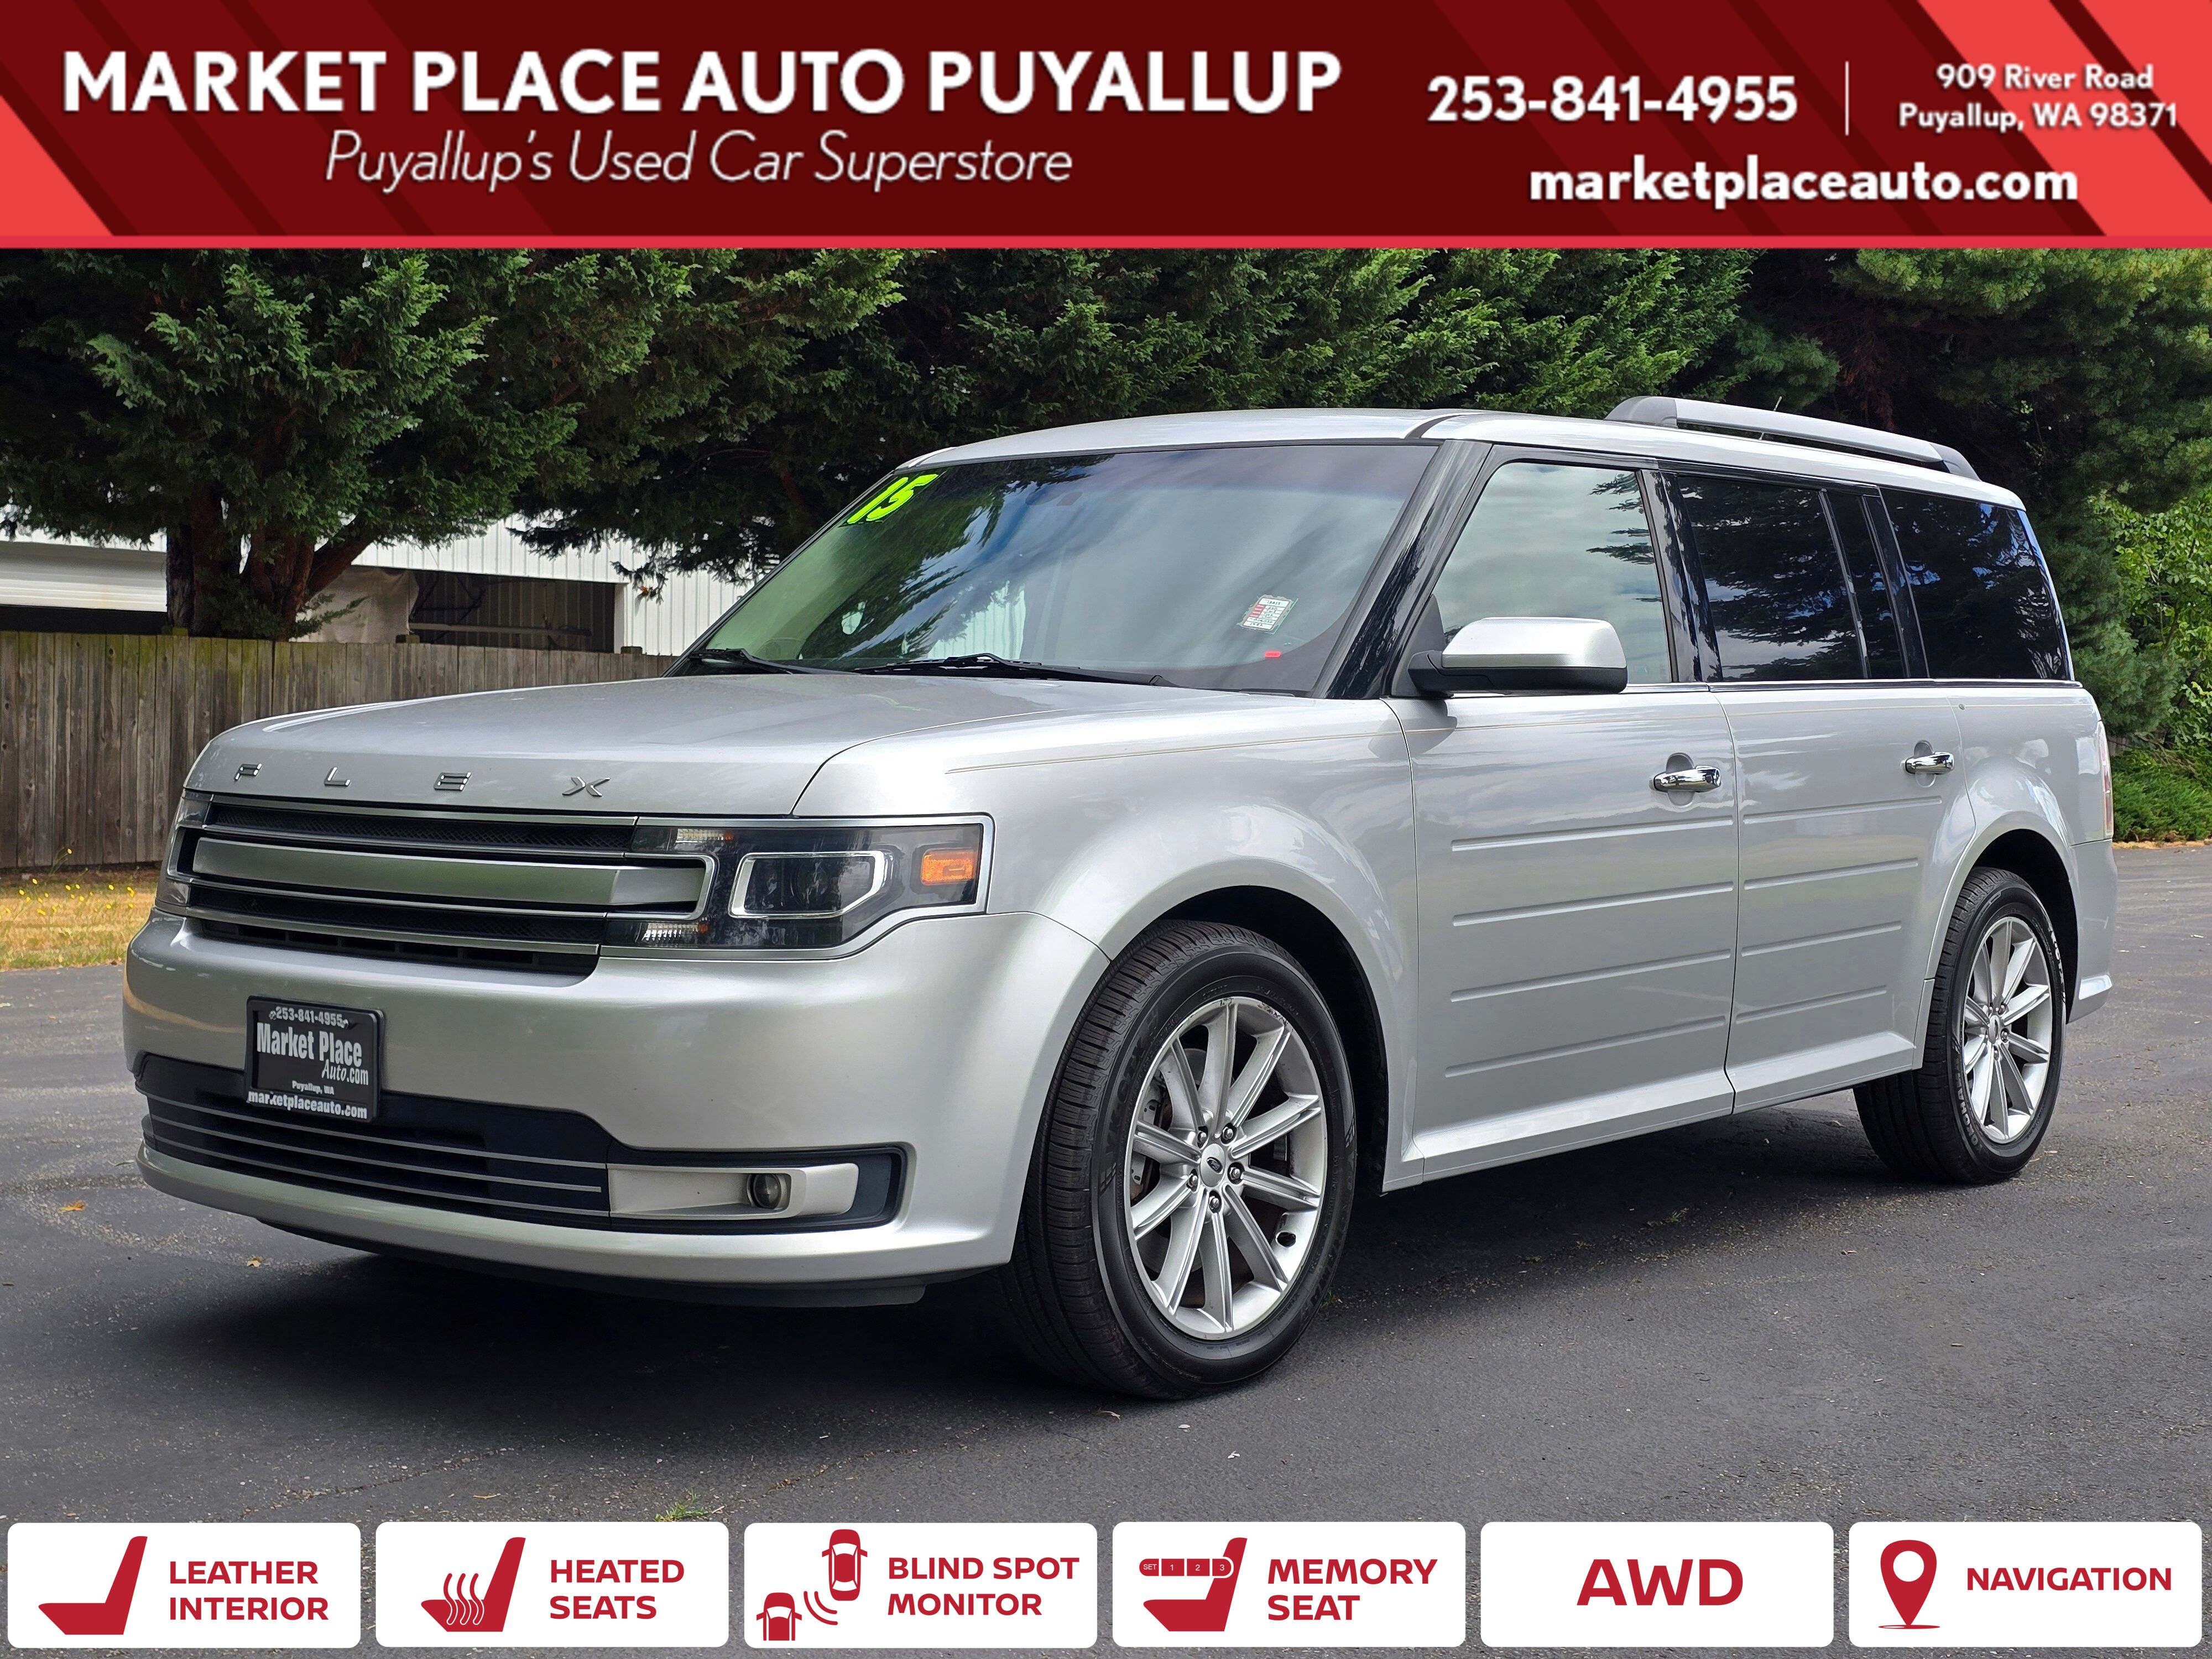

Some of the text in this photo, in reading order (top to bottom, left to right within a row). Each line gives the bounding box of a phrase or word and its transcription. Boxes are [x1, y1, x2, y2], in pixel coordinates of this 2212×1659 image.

[847, 473, 940, 524] 15
[233, 762, 611, 798] FLEX
[275, 1006, 343, 1027] 253-841-4955
[257, 1022, 363, 1067] Market Place
[321, 1059, 369, 1086] Auto.com
[291, 1080, 335, 1095] Puyallup, WA
[247, 1091, 368, 1119] marketplaceauto.com
